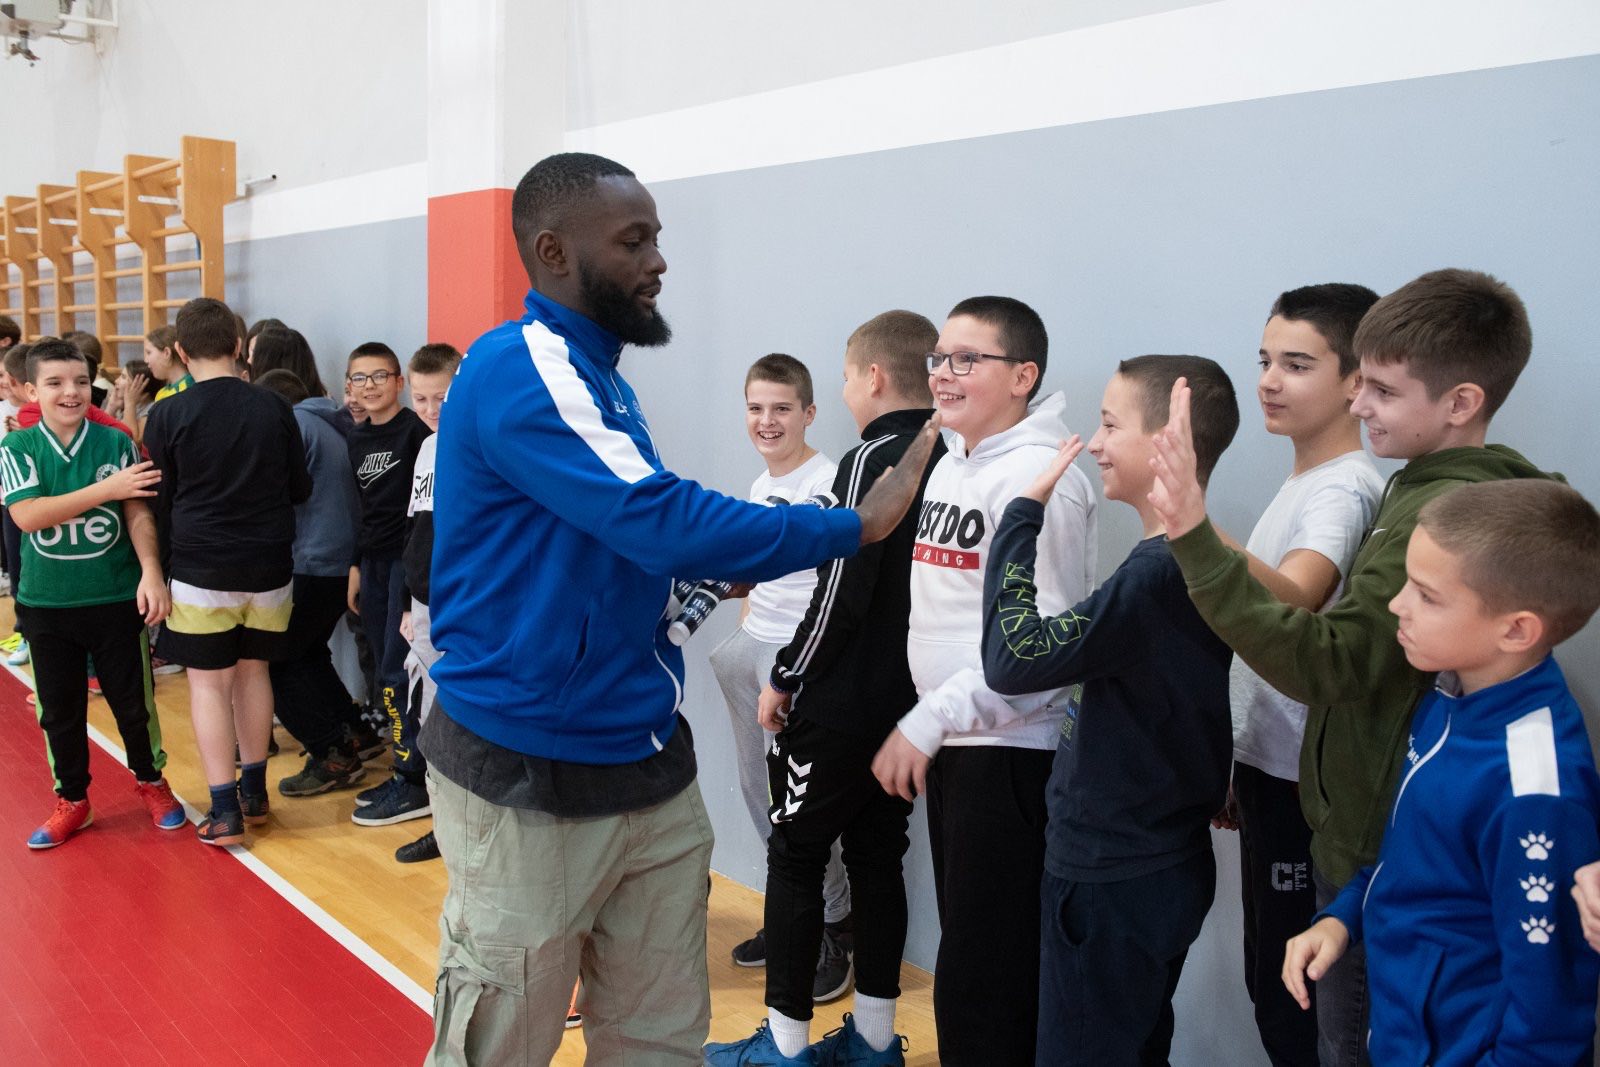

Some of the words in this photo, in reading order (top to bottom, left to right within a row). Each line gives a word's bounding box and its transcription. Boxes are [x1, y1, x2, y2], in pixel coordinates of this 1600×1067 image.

[358, 452, 392, 474] NIKE
[916, 500, 948, 542] UST
[937, 504, 985, 549] DO
[912, 545, 963, 566] OTHING
